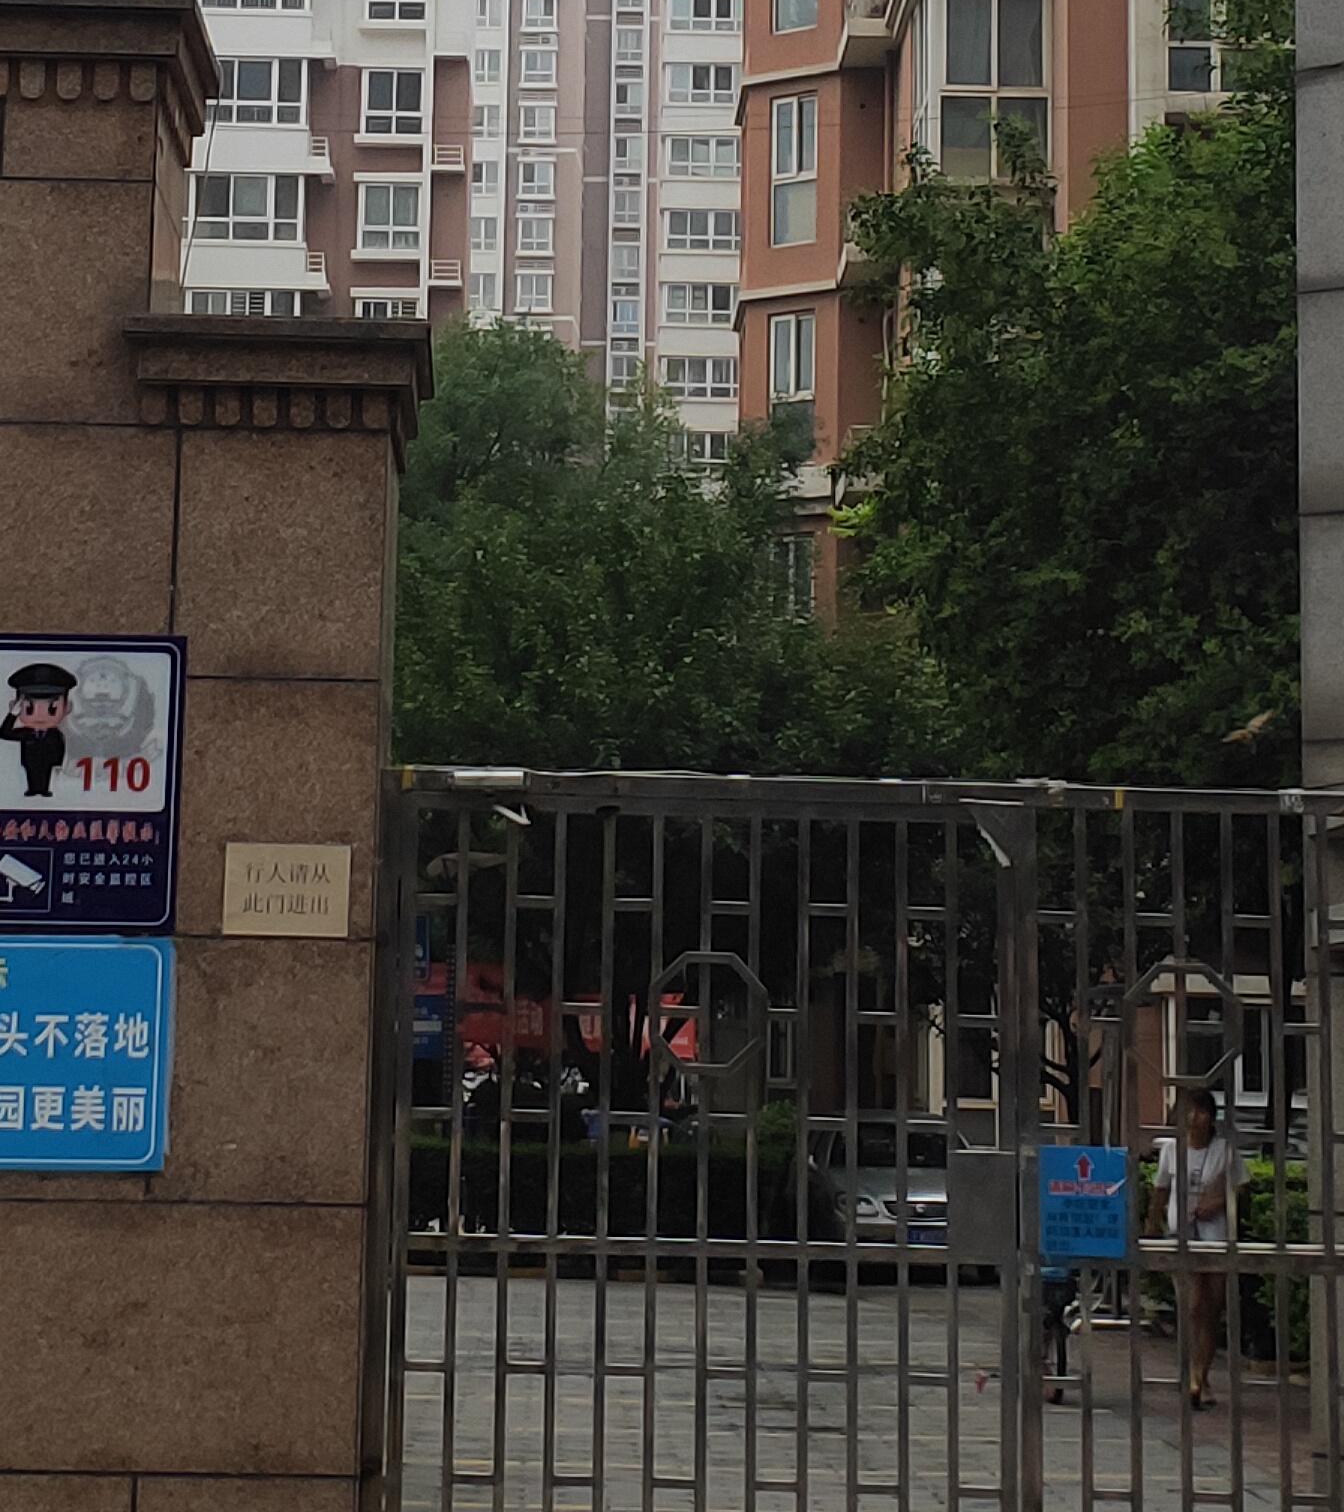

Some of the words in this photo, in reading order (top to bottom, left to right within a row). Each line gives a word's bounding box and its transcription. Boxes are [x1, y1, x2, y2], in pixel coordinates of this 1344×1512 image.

[74, 755, 151, 792] 110
[245, 861, 331, 885] 行人请从
[242, 891, 329, 915] 此门进出
